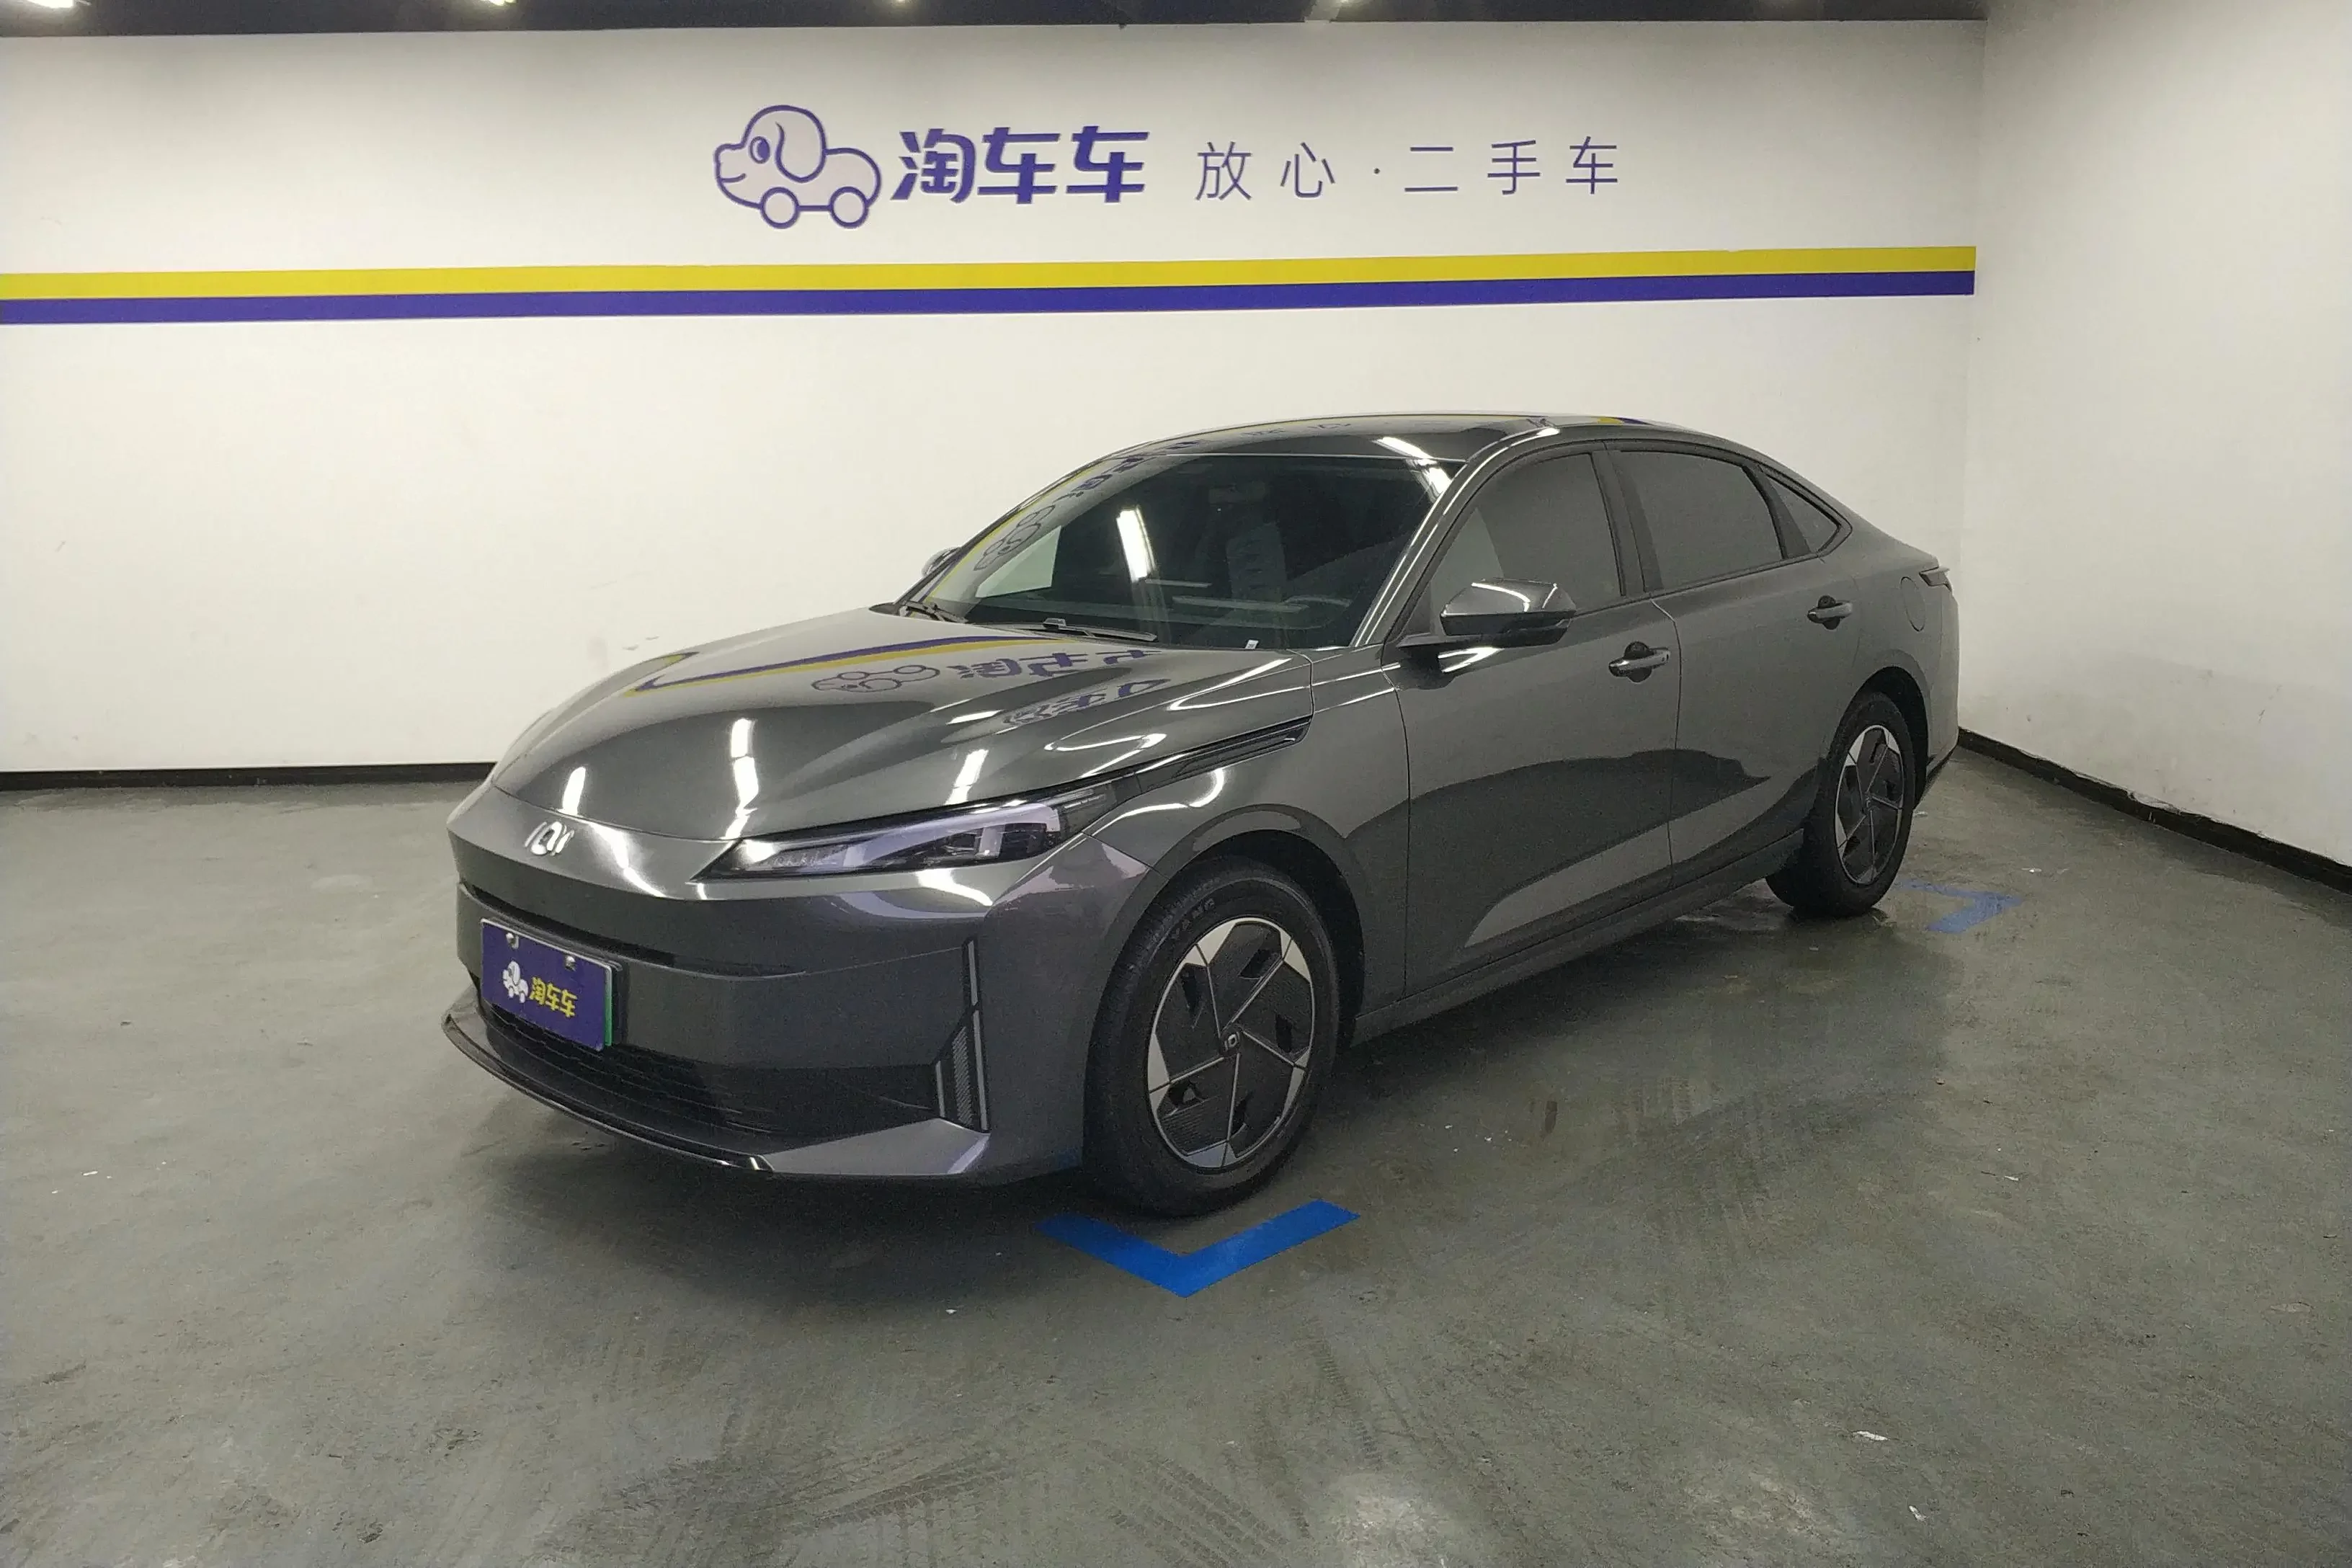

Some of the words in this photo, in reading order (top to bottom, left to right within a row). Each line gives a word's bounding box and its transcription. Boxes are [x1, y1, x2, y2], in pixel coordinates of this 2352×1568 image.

[891, 125, 1148, 203] 淘车车
[1195, 135, 1618, 201] 放心·二手车
[529, 976, 577, 1017] 淘车车
